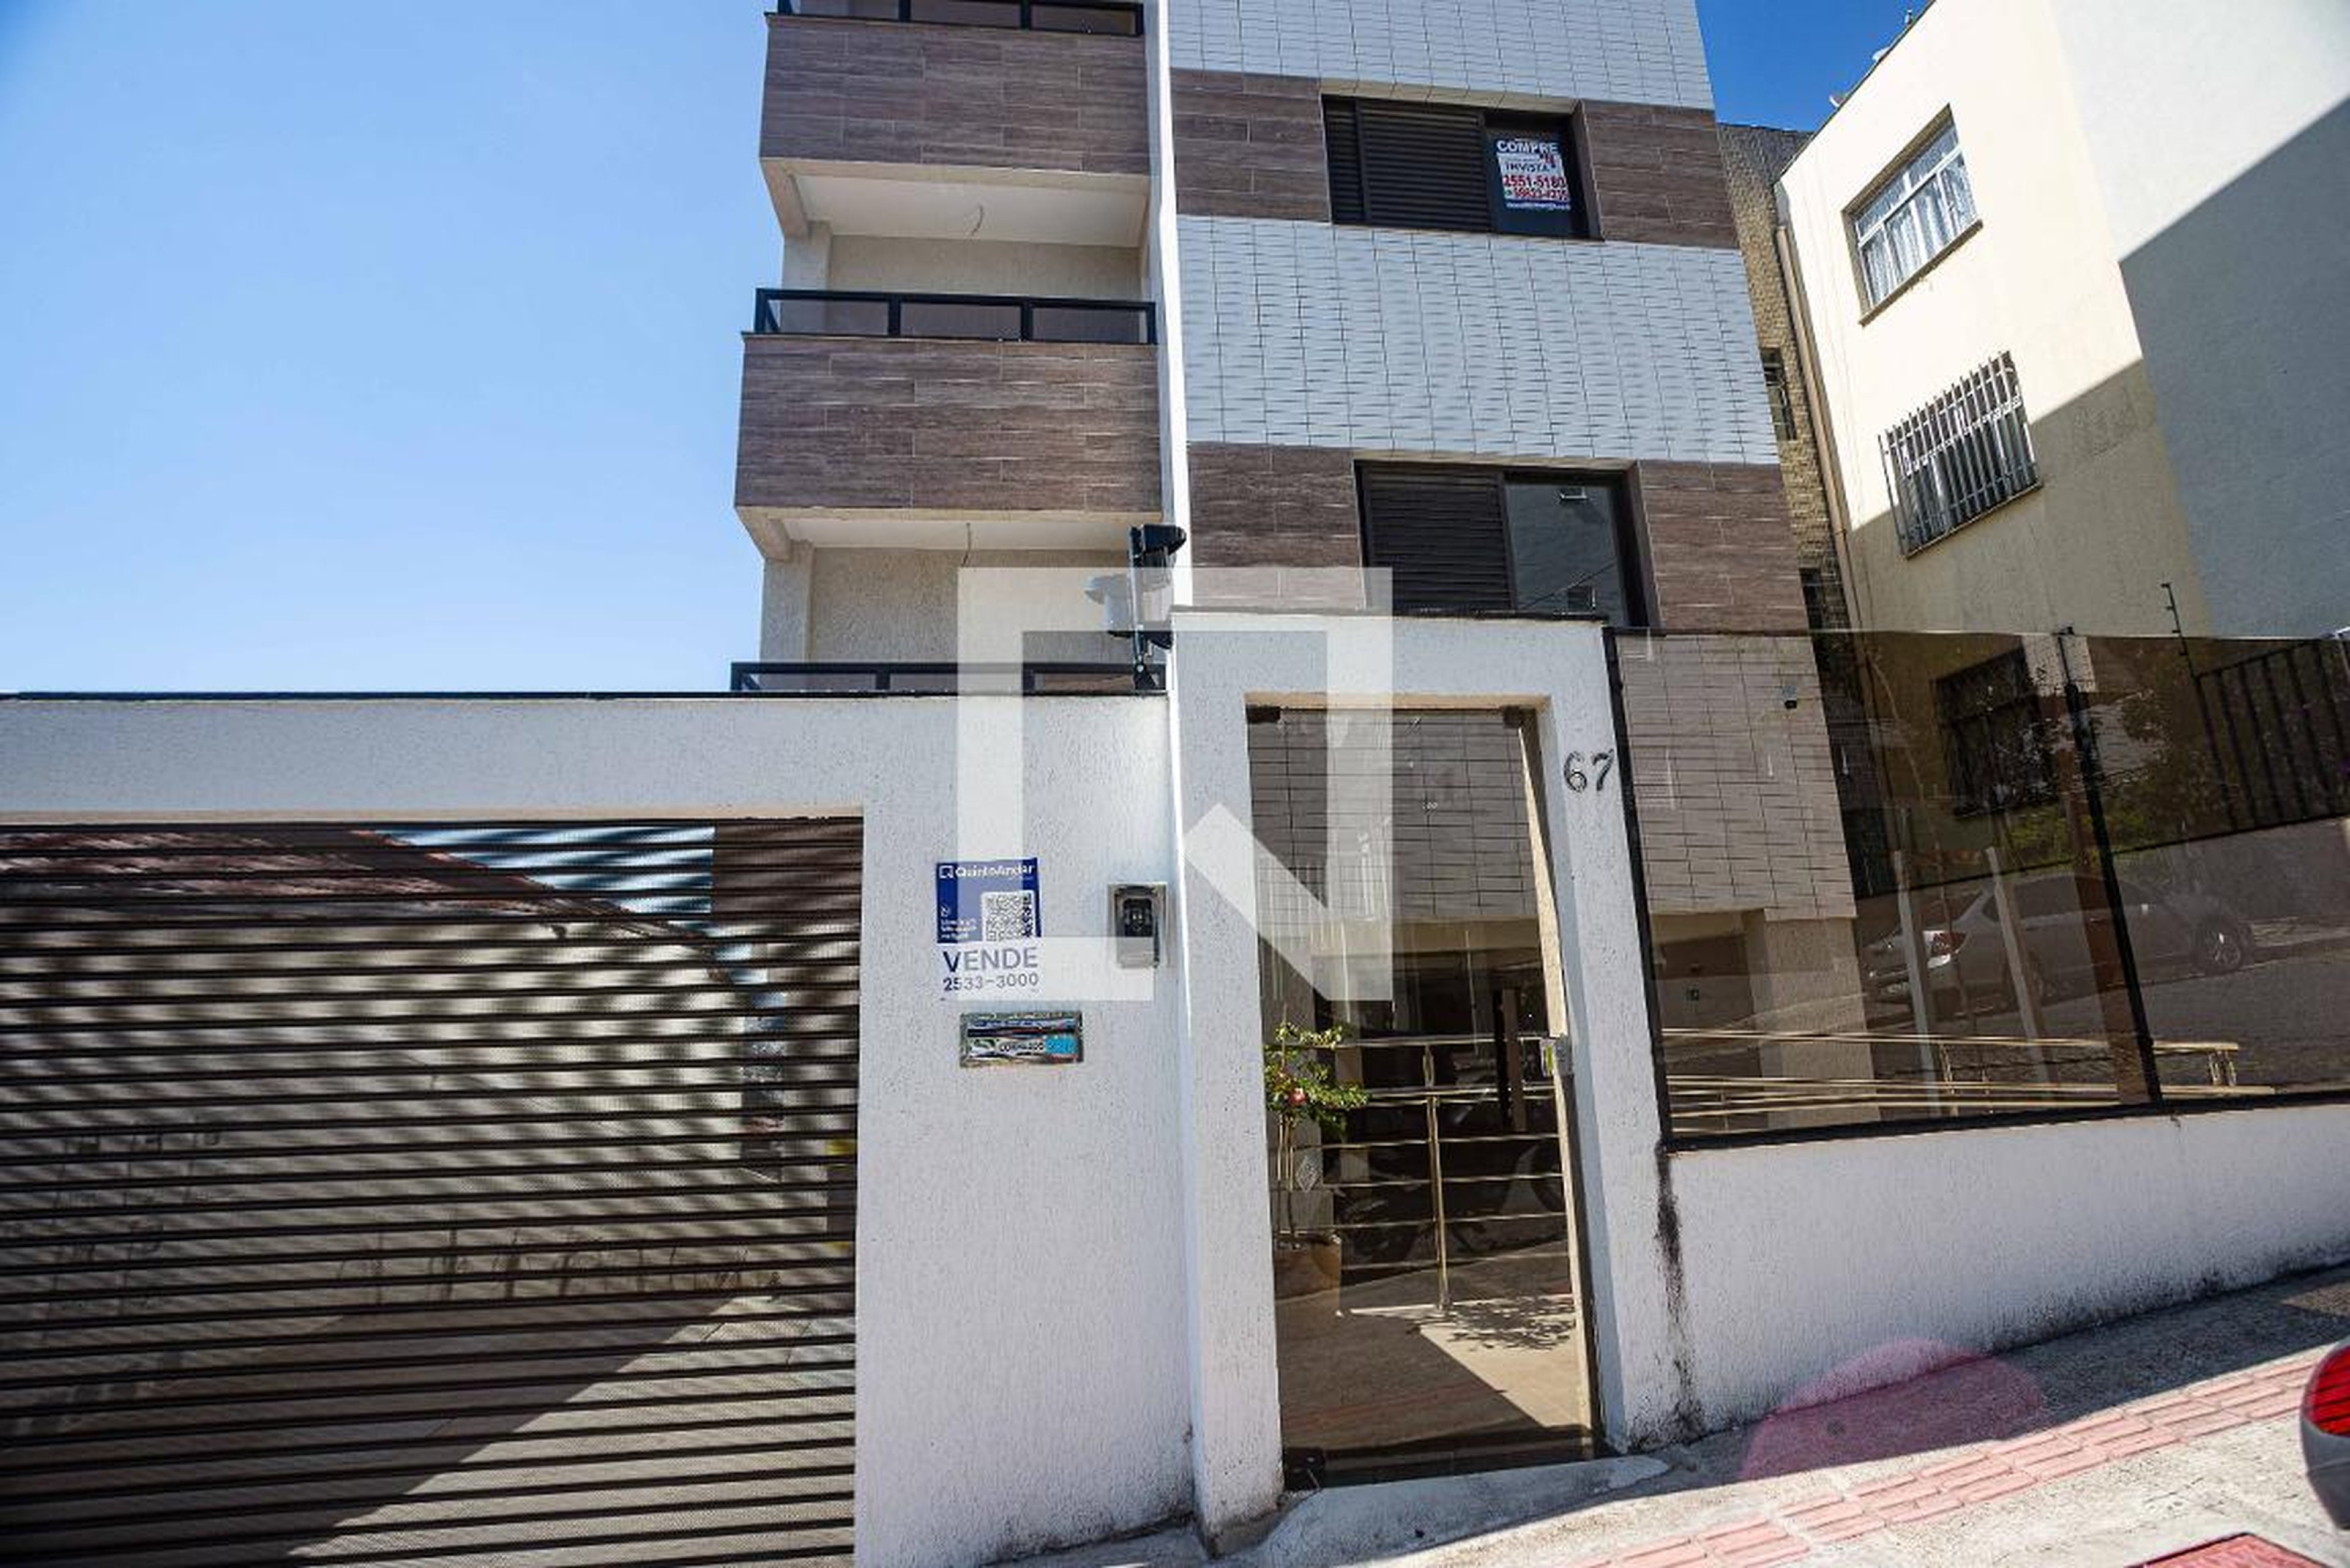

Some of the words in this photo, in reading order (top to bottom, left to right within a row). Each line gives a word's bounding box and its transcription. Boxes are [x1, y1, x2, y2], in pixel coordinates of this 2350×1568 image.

[1497, 140, 1559, 154] COMPRE
[1564, 748, 1614, 793] 67
[943, 947, 1038, 972] VENDE
[943, 973, 1039, 991] 2533-3000
